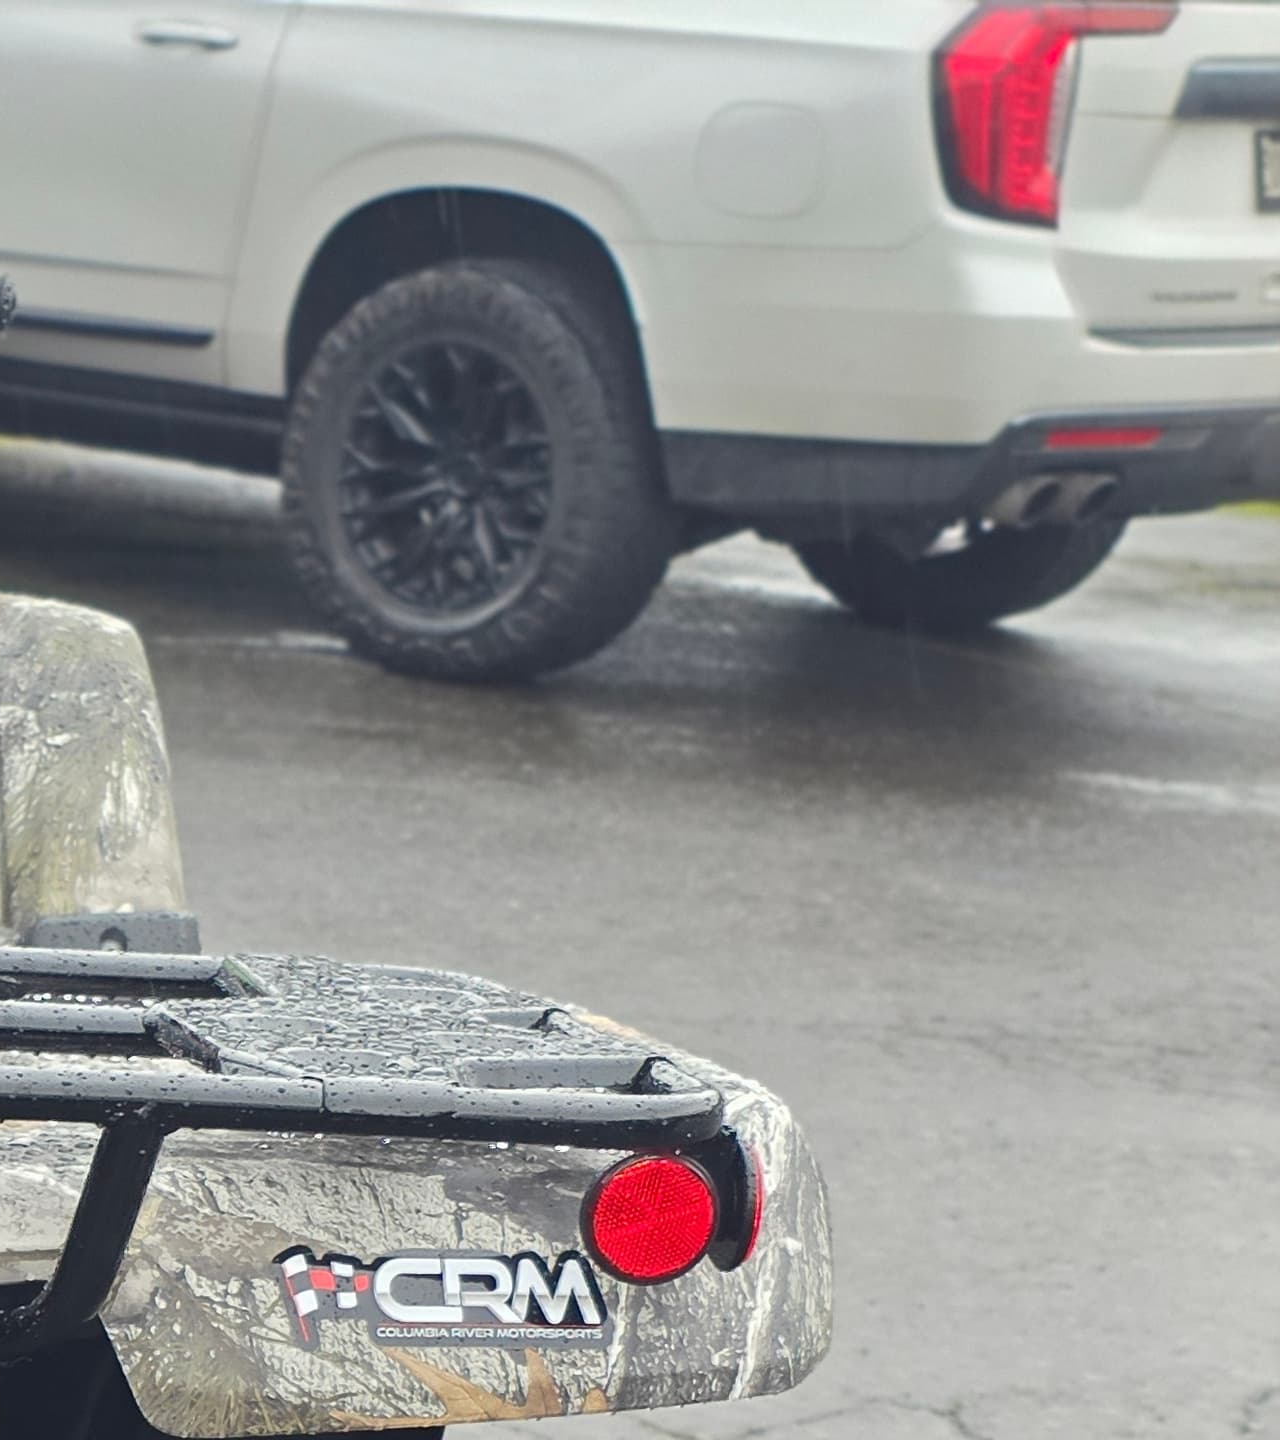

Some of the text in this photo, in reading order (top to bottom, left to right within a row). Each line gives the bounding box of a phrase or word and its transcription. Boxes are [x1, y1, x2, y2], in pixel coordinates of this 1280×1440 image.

[373, 1257, 602, 1325] CRM
[376, 1327, 603, 1340] COLUMBIA RIVER MOTORSPORTS
